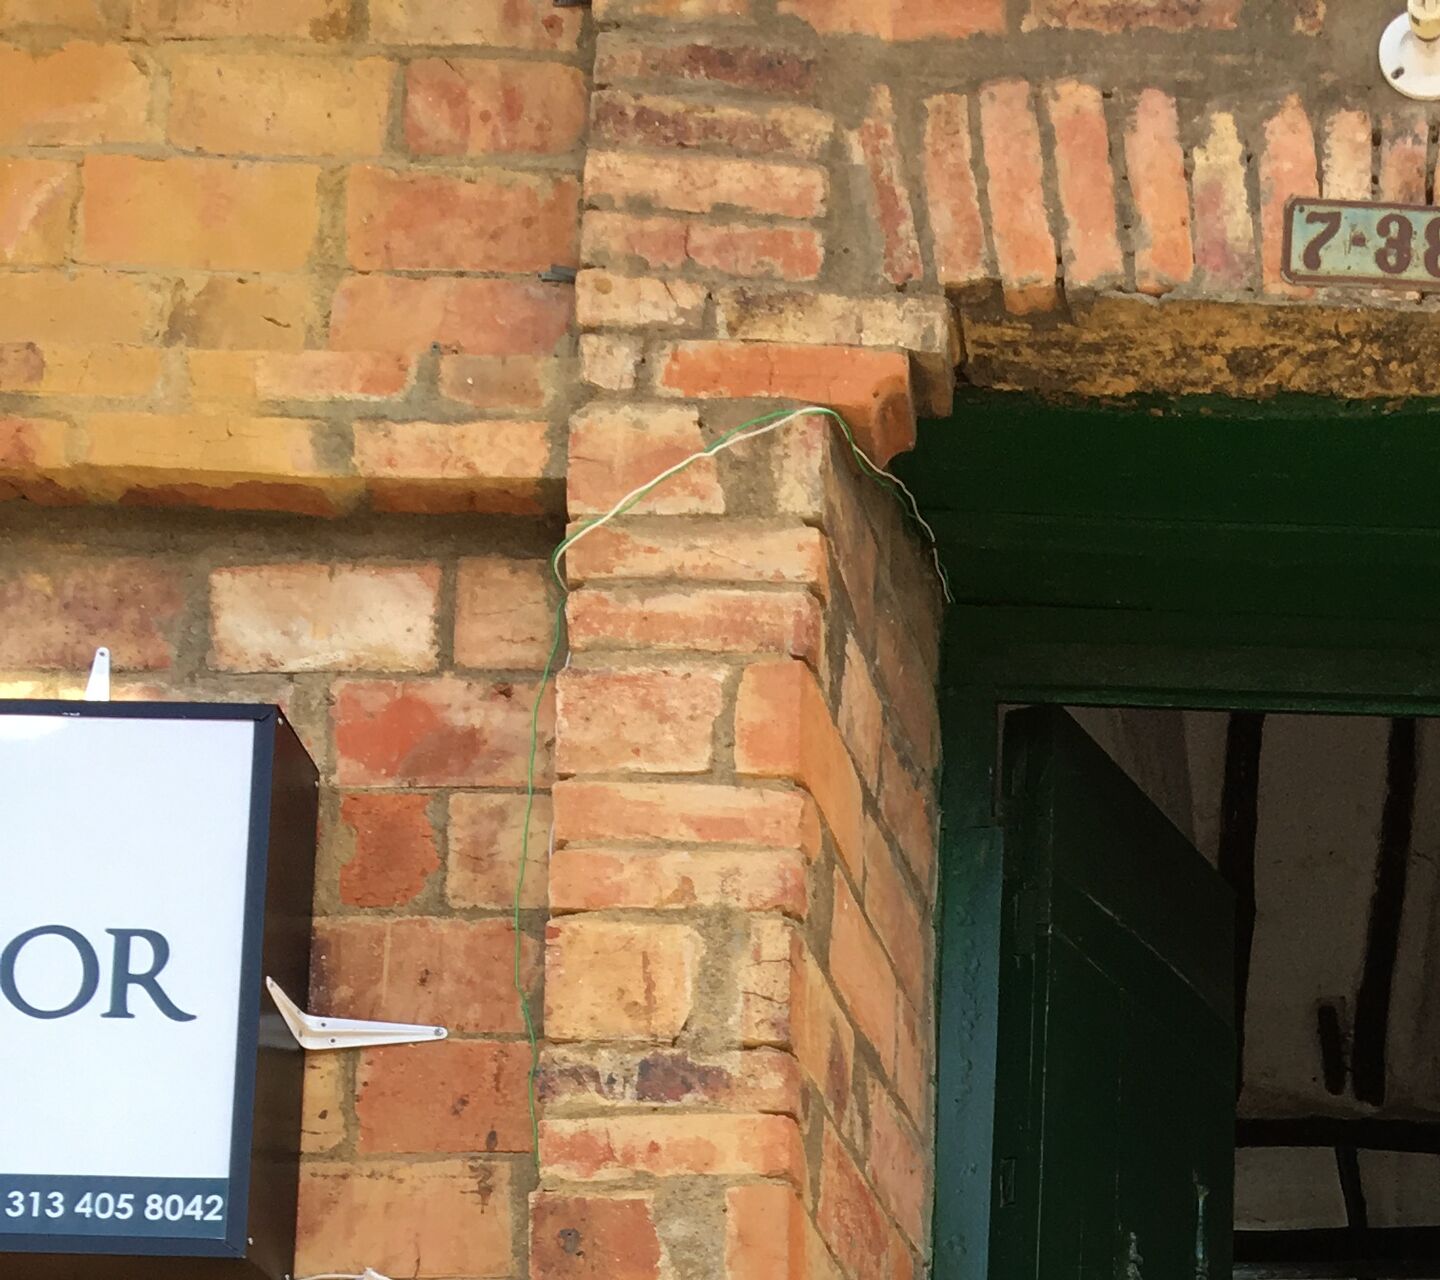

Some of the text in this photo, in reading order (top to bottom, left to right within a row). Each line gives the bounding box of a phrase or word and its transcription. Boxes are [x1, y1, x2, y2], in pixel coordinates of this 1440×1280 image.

[5, 1190, 224, 1221] 313 405 8042
